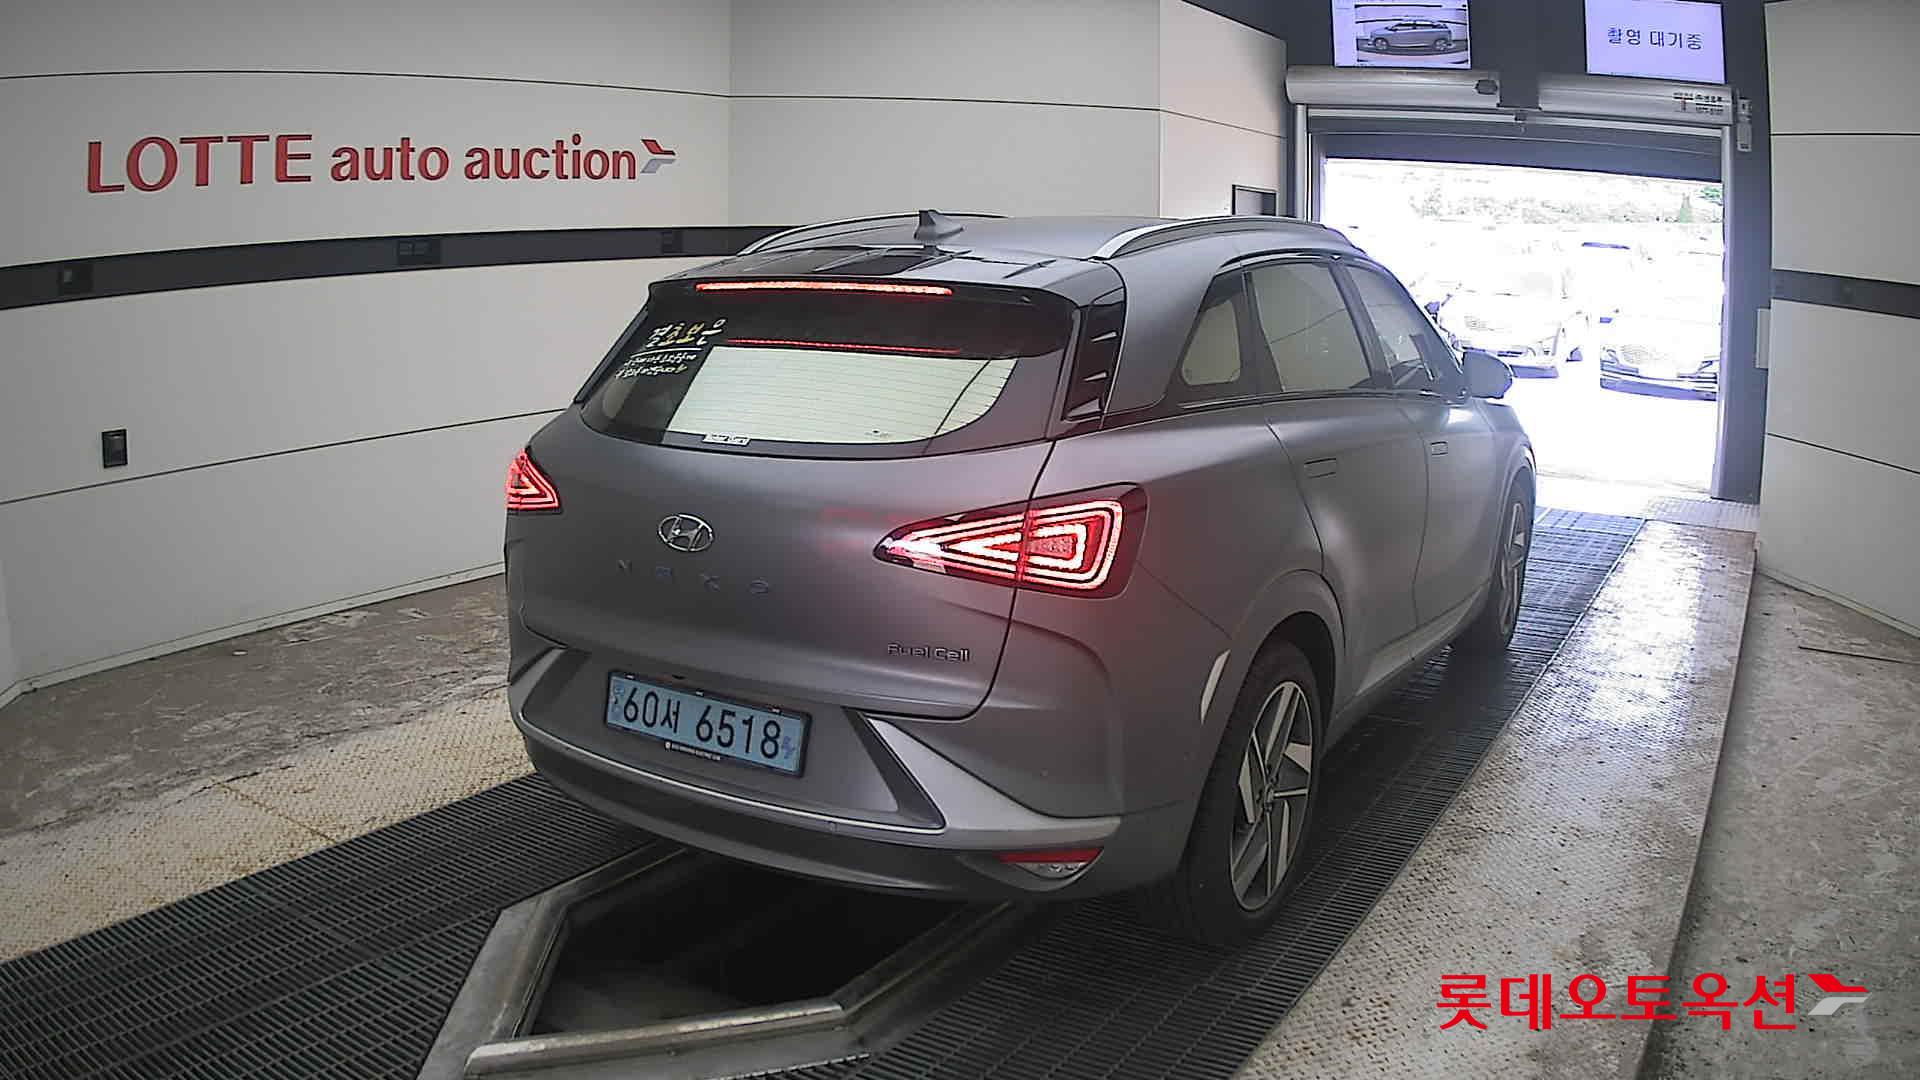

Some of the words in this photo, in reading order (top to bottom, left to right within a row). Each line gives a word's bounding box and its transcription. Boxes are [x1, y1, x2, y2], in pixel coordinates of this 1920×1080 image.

[1608, 27, 1641, 46] 촬영
[1649, 30, 1702, 50] 대기중
[87, 134, 313, 194] LOTTE
[331, 137, 450, 182] auto
[464, 133, 637, 180] auction
[887, 643, 930, 658] Fuel
[934, 647, 970, 662] Cell
[623, 687, 681, 734] 60서
[695, 705, 782, 759] 6518
